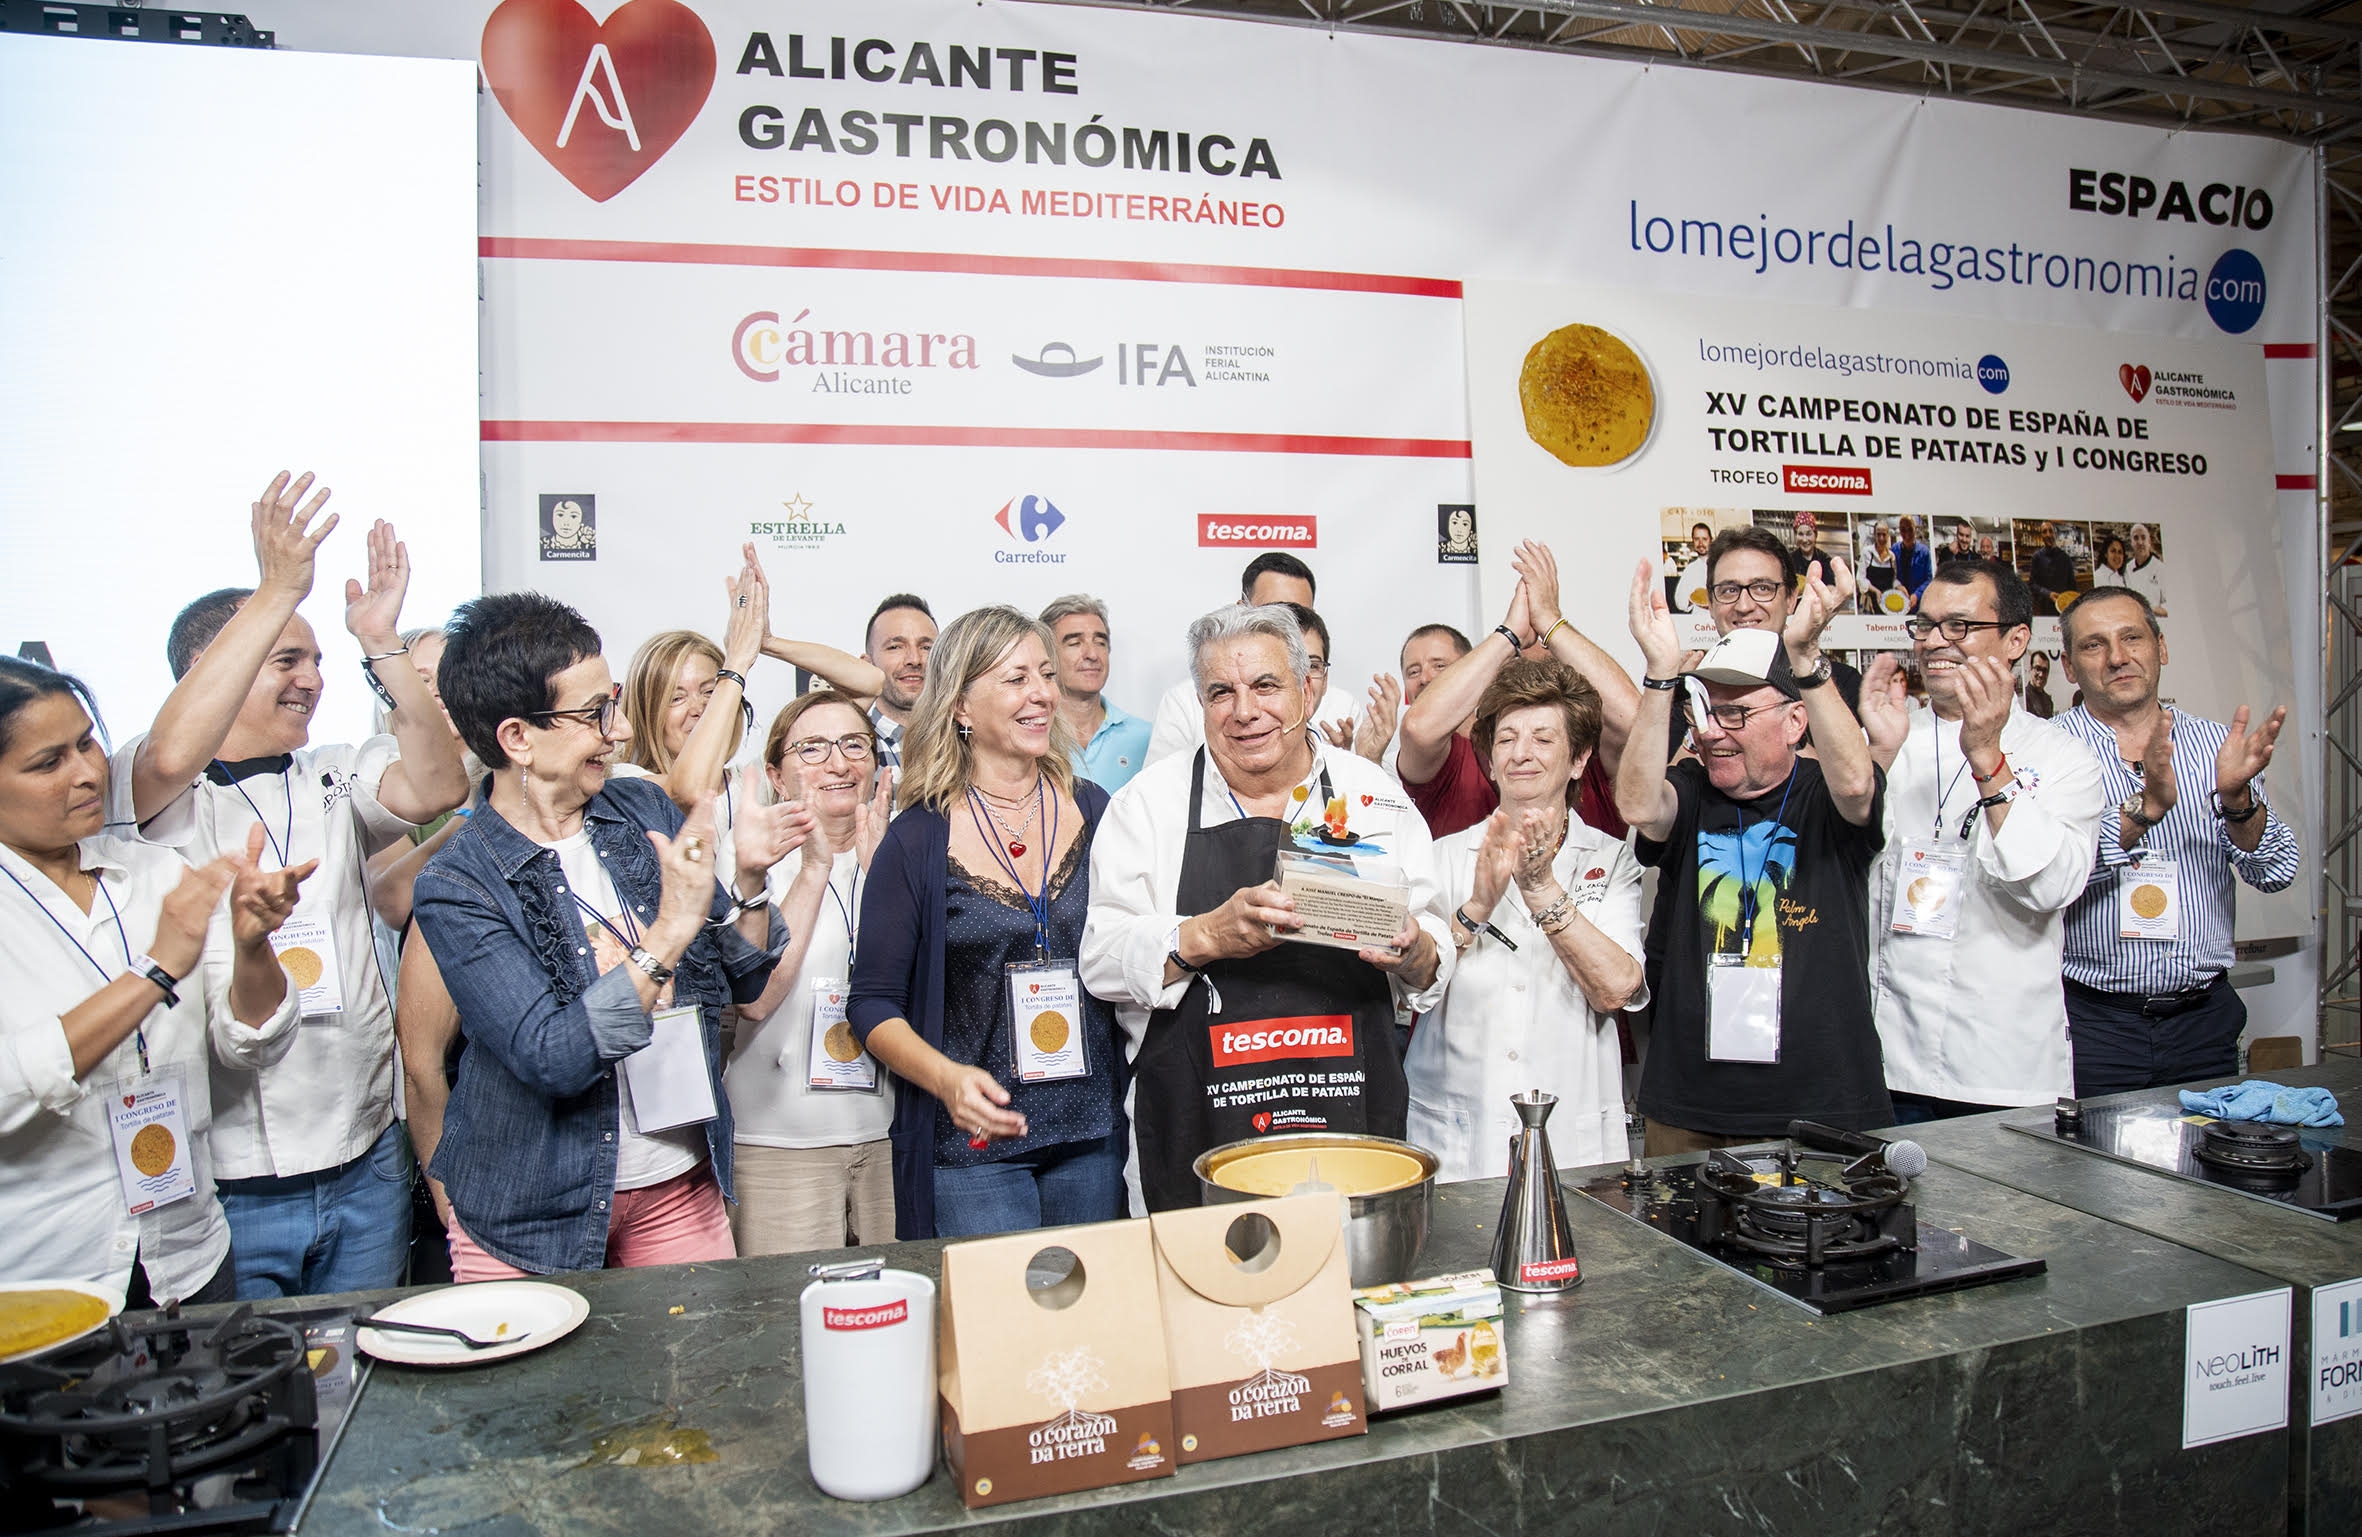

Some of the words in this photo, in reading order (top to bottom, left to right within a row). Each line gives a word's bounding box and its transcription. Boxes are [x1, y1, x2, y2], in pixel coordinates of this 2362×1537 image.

[736, 31, 1079, 95] ALICANTE
[738, 105, 1282, 180] GASTRONÓMICA
[735, 174, 862, 208] ESTILO
[873, 182, 919, 209] DE
[929, 184, 1012, 214] VIDA
[1021, 190, 1286, 229] MEDITERRÁNEO
[2069, 168, 2274, 231] ESPACIO
[1631, 199, 2199, 302] lomejordelagastronomia
[2207, 277, 2262, 304] com
[1205, 345, 1275, 357] INSTITUCIÓN
[1118, 342, 1198, 388] IFA
[1205, 358, 1241, 369] FERIAL
[1699, 337, 1974, 380] lomejordelagastronomia
[1977, 365, 2008, 382] com
[811, 371, 913, 395] Alicante
[1205, 371, 1270, 382] ALICANTINA
[2154, 371, 2204, 384] ALICANTE
[2155, 385, 2236, 401] GASTRONÓMICA
[1705, 391, 1747, 416] XV
[1757, 394, 1957, 428] CAMPEONATO
[1966, 407, 2001, 431] DE
[2009, 410, 2110, 438] ESPAÑA
[2117, 416, 2149, 440] DE
[1707, 427, 1857, 458] TORTILLA
[1865, 435, 1902, 459] DE
[1911, 438, 2027, 466] PATATAS
[2034, 449, 2049, 472] y
[2056, 446, 2065, 468] I
[2072, 447, 2208, 476] CONGRESO
[1710, 469, 1779, 485] TROFEO
[750, 522, 847, 535] ESTRELLA
[546, 550, 591, 560] Carmencita
[994, 550, 1067, 565] Carrefour
[1694, 623, 1716, 631] Caña
[1865, 624, 1897, 632] Taberna
[1779, 898, 1807, 914] Palm
[1782, 908, 1819, 932] Angels
[270, 930, 314, 940] ONGRESO
[2235, 942, 2267, 955] rrefour
[1026, 995, 1063, 1003] CONGRESO
[1206, 1084, 1219, 1096] XV
[1221, 1073, 1306, 1094] CAMPEONATO
[1308, 1073, 1326, 1085] DE
[1213, 1098, 1227, 1109] DE
[1229, 1087, 1289, 1106] TORTILLA
[1292, 1086, 1309, 1098] DE
[1312, 1085, 1360, 1098] PATATAS
[120, 1103, 165, 1122] CONGRESO
[166, 1099, 177, 1107] DE
[1272, 1109, 1306, 1118] ALICANTE
[1272, 1116, 1327, 1125] GASTRONÓMICA
[1380, 1342, 1427, 1361] HUEVOS
[1382, 1360, 1429, 1378] CORRAL
